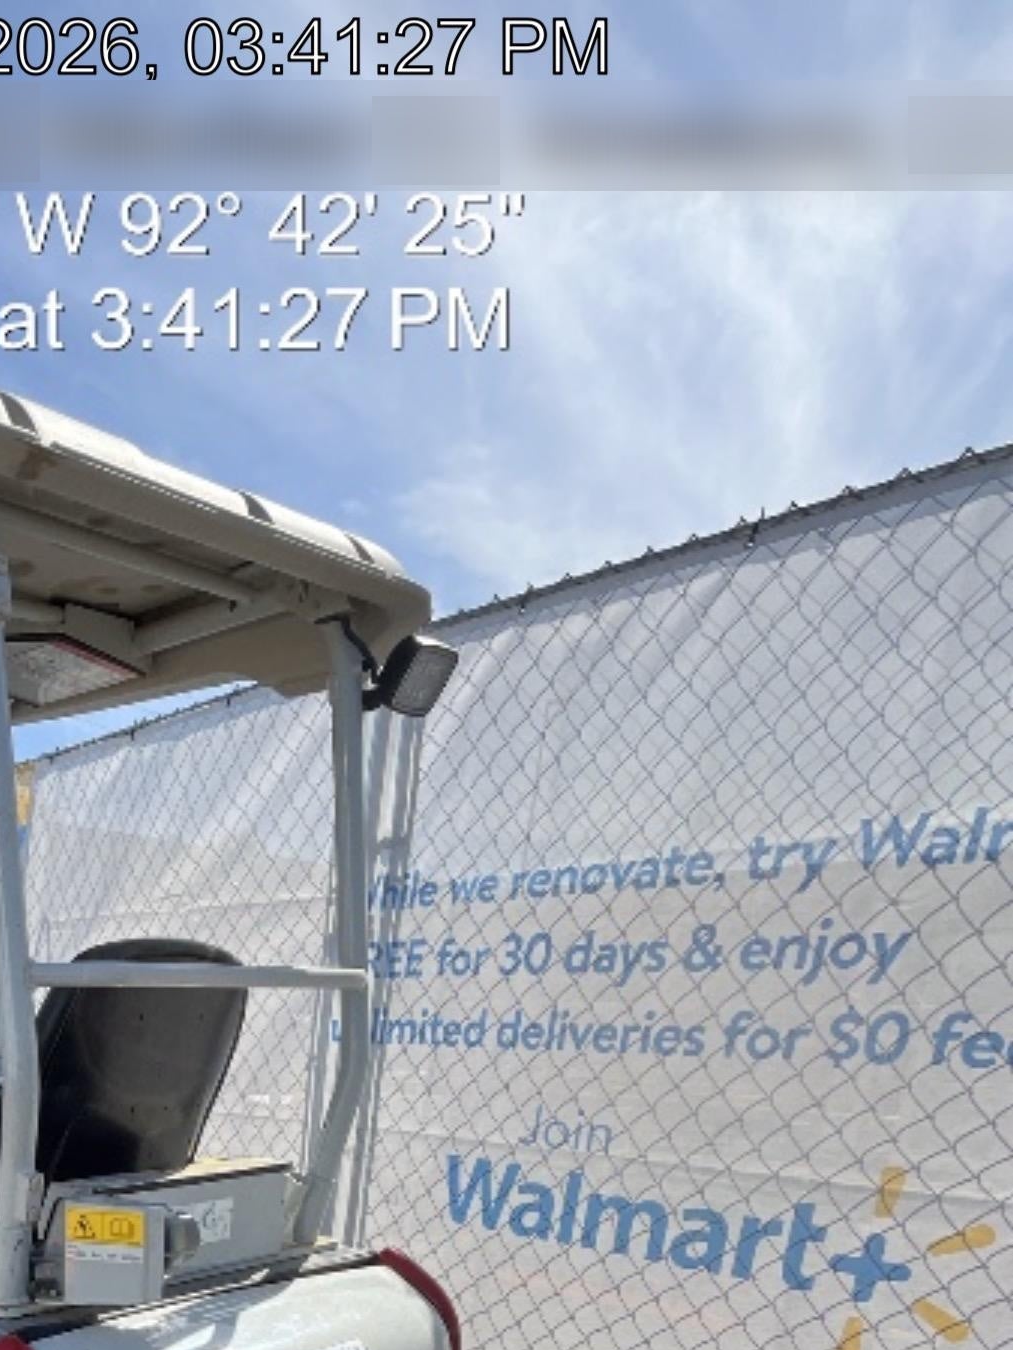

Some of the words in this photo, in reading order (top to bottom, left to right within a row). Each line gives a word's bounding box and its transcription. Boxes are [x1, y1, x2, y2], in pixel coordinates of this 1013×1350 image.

[450, 872, 499, 903] we
[510, 845, 726, 902] renovate,
[749, 836, 837, 894] try
[367, 936, 429, 979] REE
[437, 937, 491, 978] for
[498, 931, 552, 977] 30
[564, 929, 668, 989] days
[683, 923, 724, 973] &
[740, 917, 914, 986] enjoy
[496, 1006, 706, 1057] deliveries
[723, 1010, 812, 1060] for
[826, 1003, 911, 1068] $0
[931, 1010, 1013, 1069] fe
[518, 1104, 614, 1155] Join
